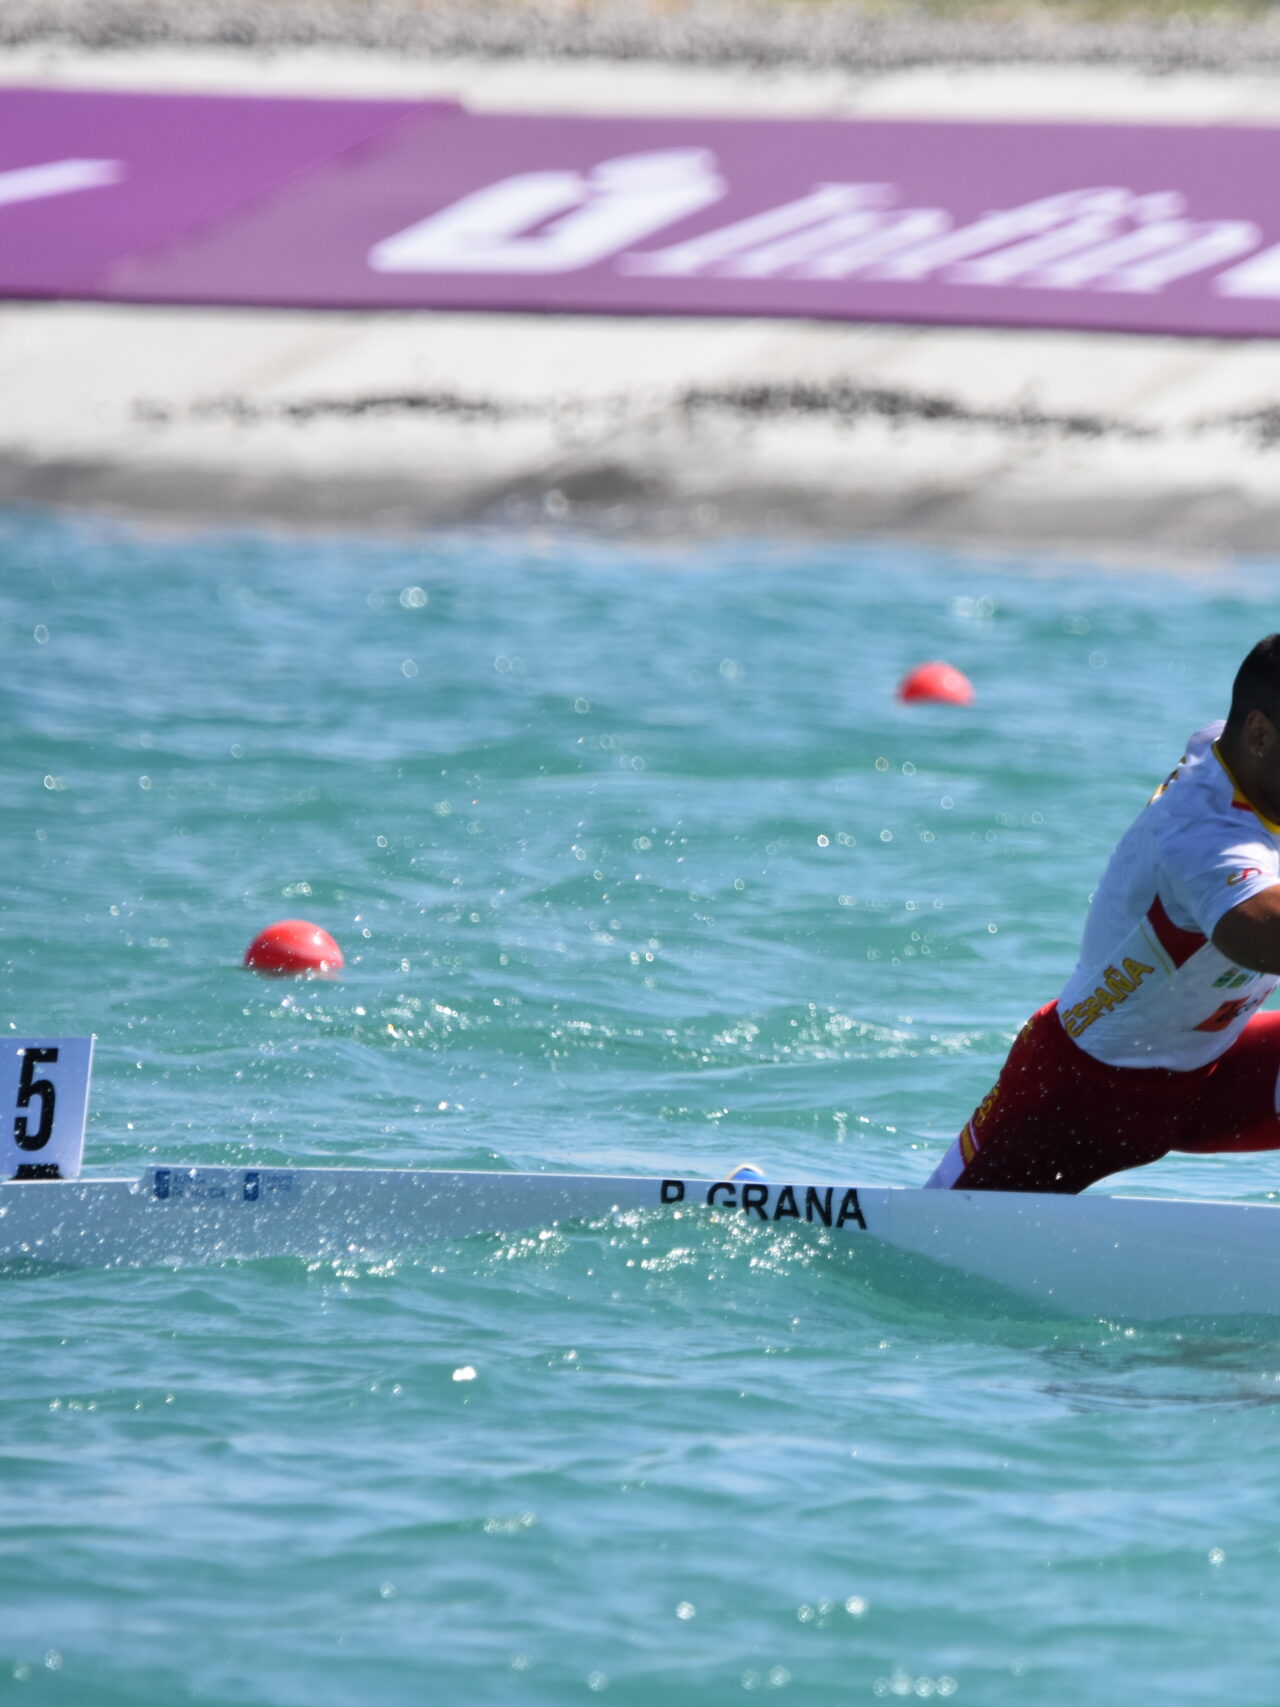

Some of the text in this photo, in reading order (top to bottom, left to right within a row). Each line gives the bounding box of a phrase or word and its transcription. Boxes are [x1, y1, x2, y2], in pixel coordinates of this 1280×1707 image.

[1062, 957, 1156, 1038] ESPAÑA
[13, 1047, 59, 1152] 5
[706, 1181, 868, 1230] GRANA
